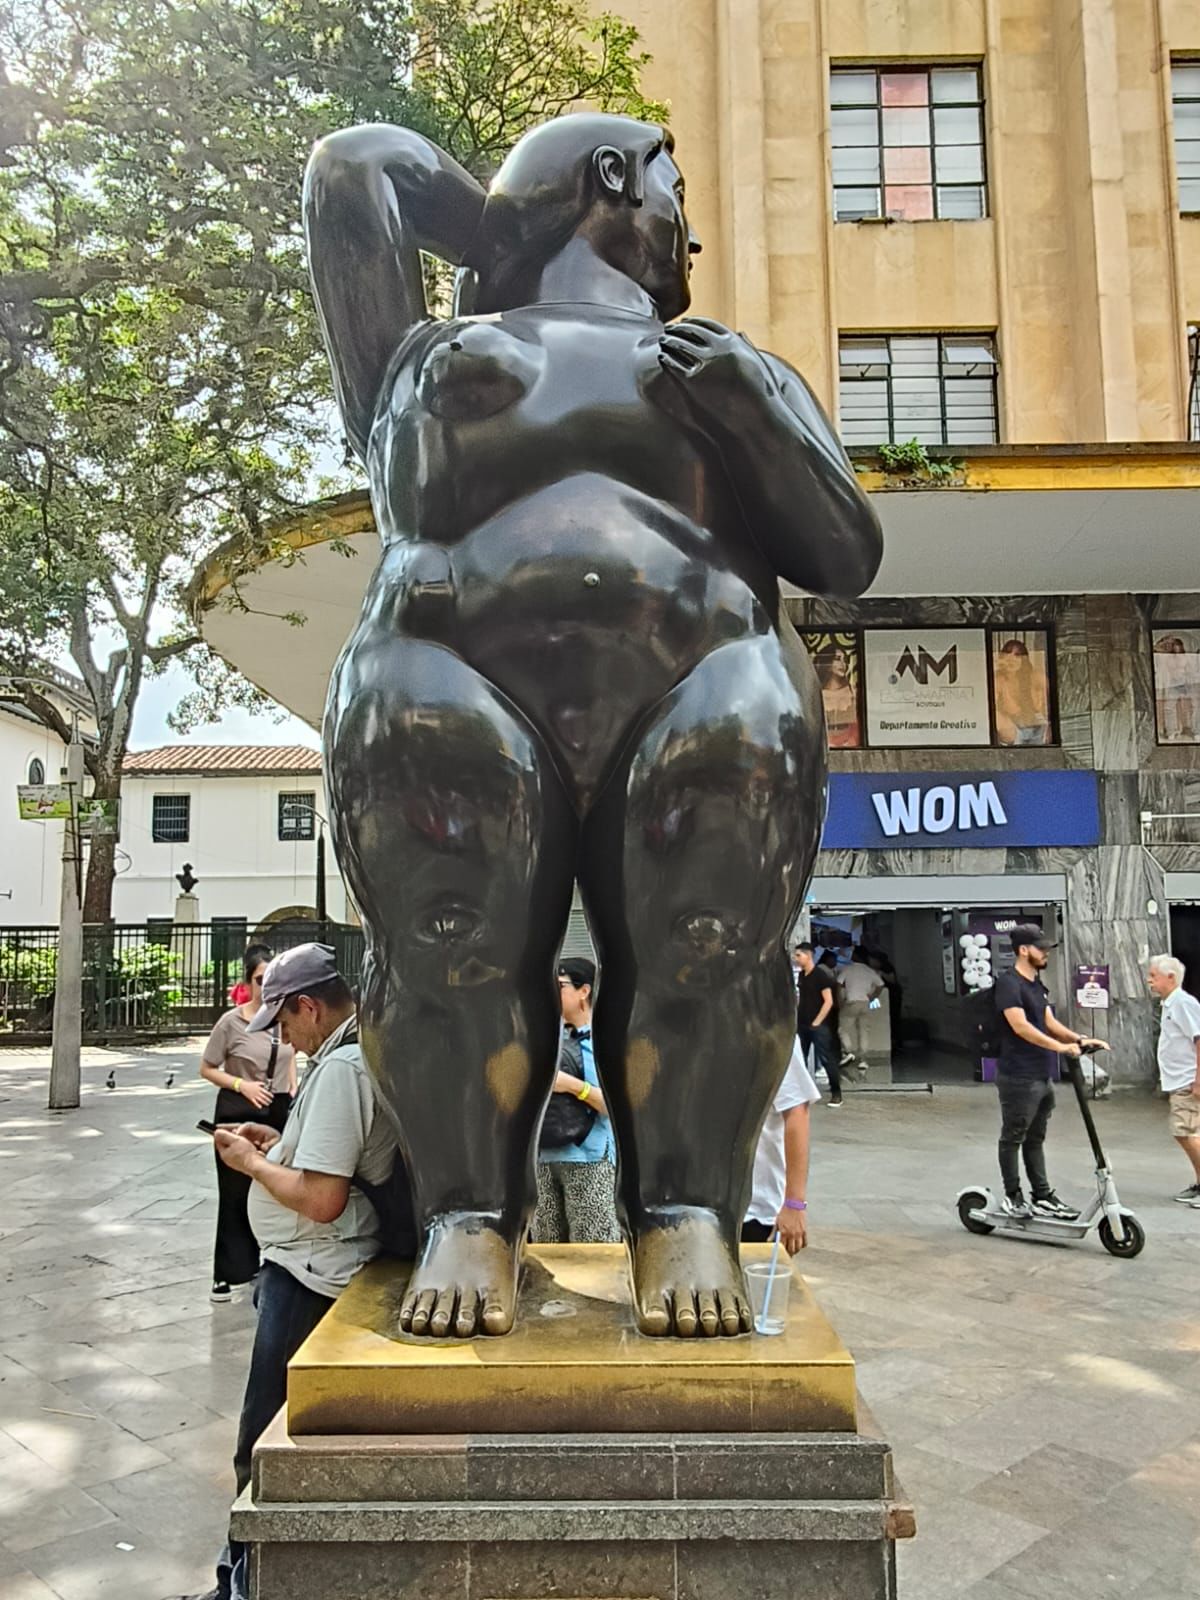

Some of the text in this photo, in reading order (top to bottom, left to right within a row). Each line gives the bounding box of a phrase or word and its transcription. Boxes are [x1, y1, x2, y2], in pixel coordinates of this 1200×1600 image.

[880, 719, 977, 731] Departamento Creativo
[871, 781, 1008, 836] WOM
[994, 919, 1017, 930] WOM
